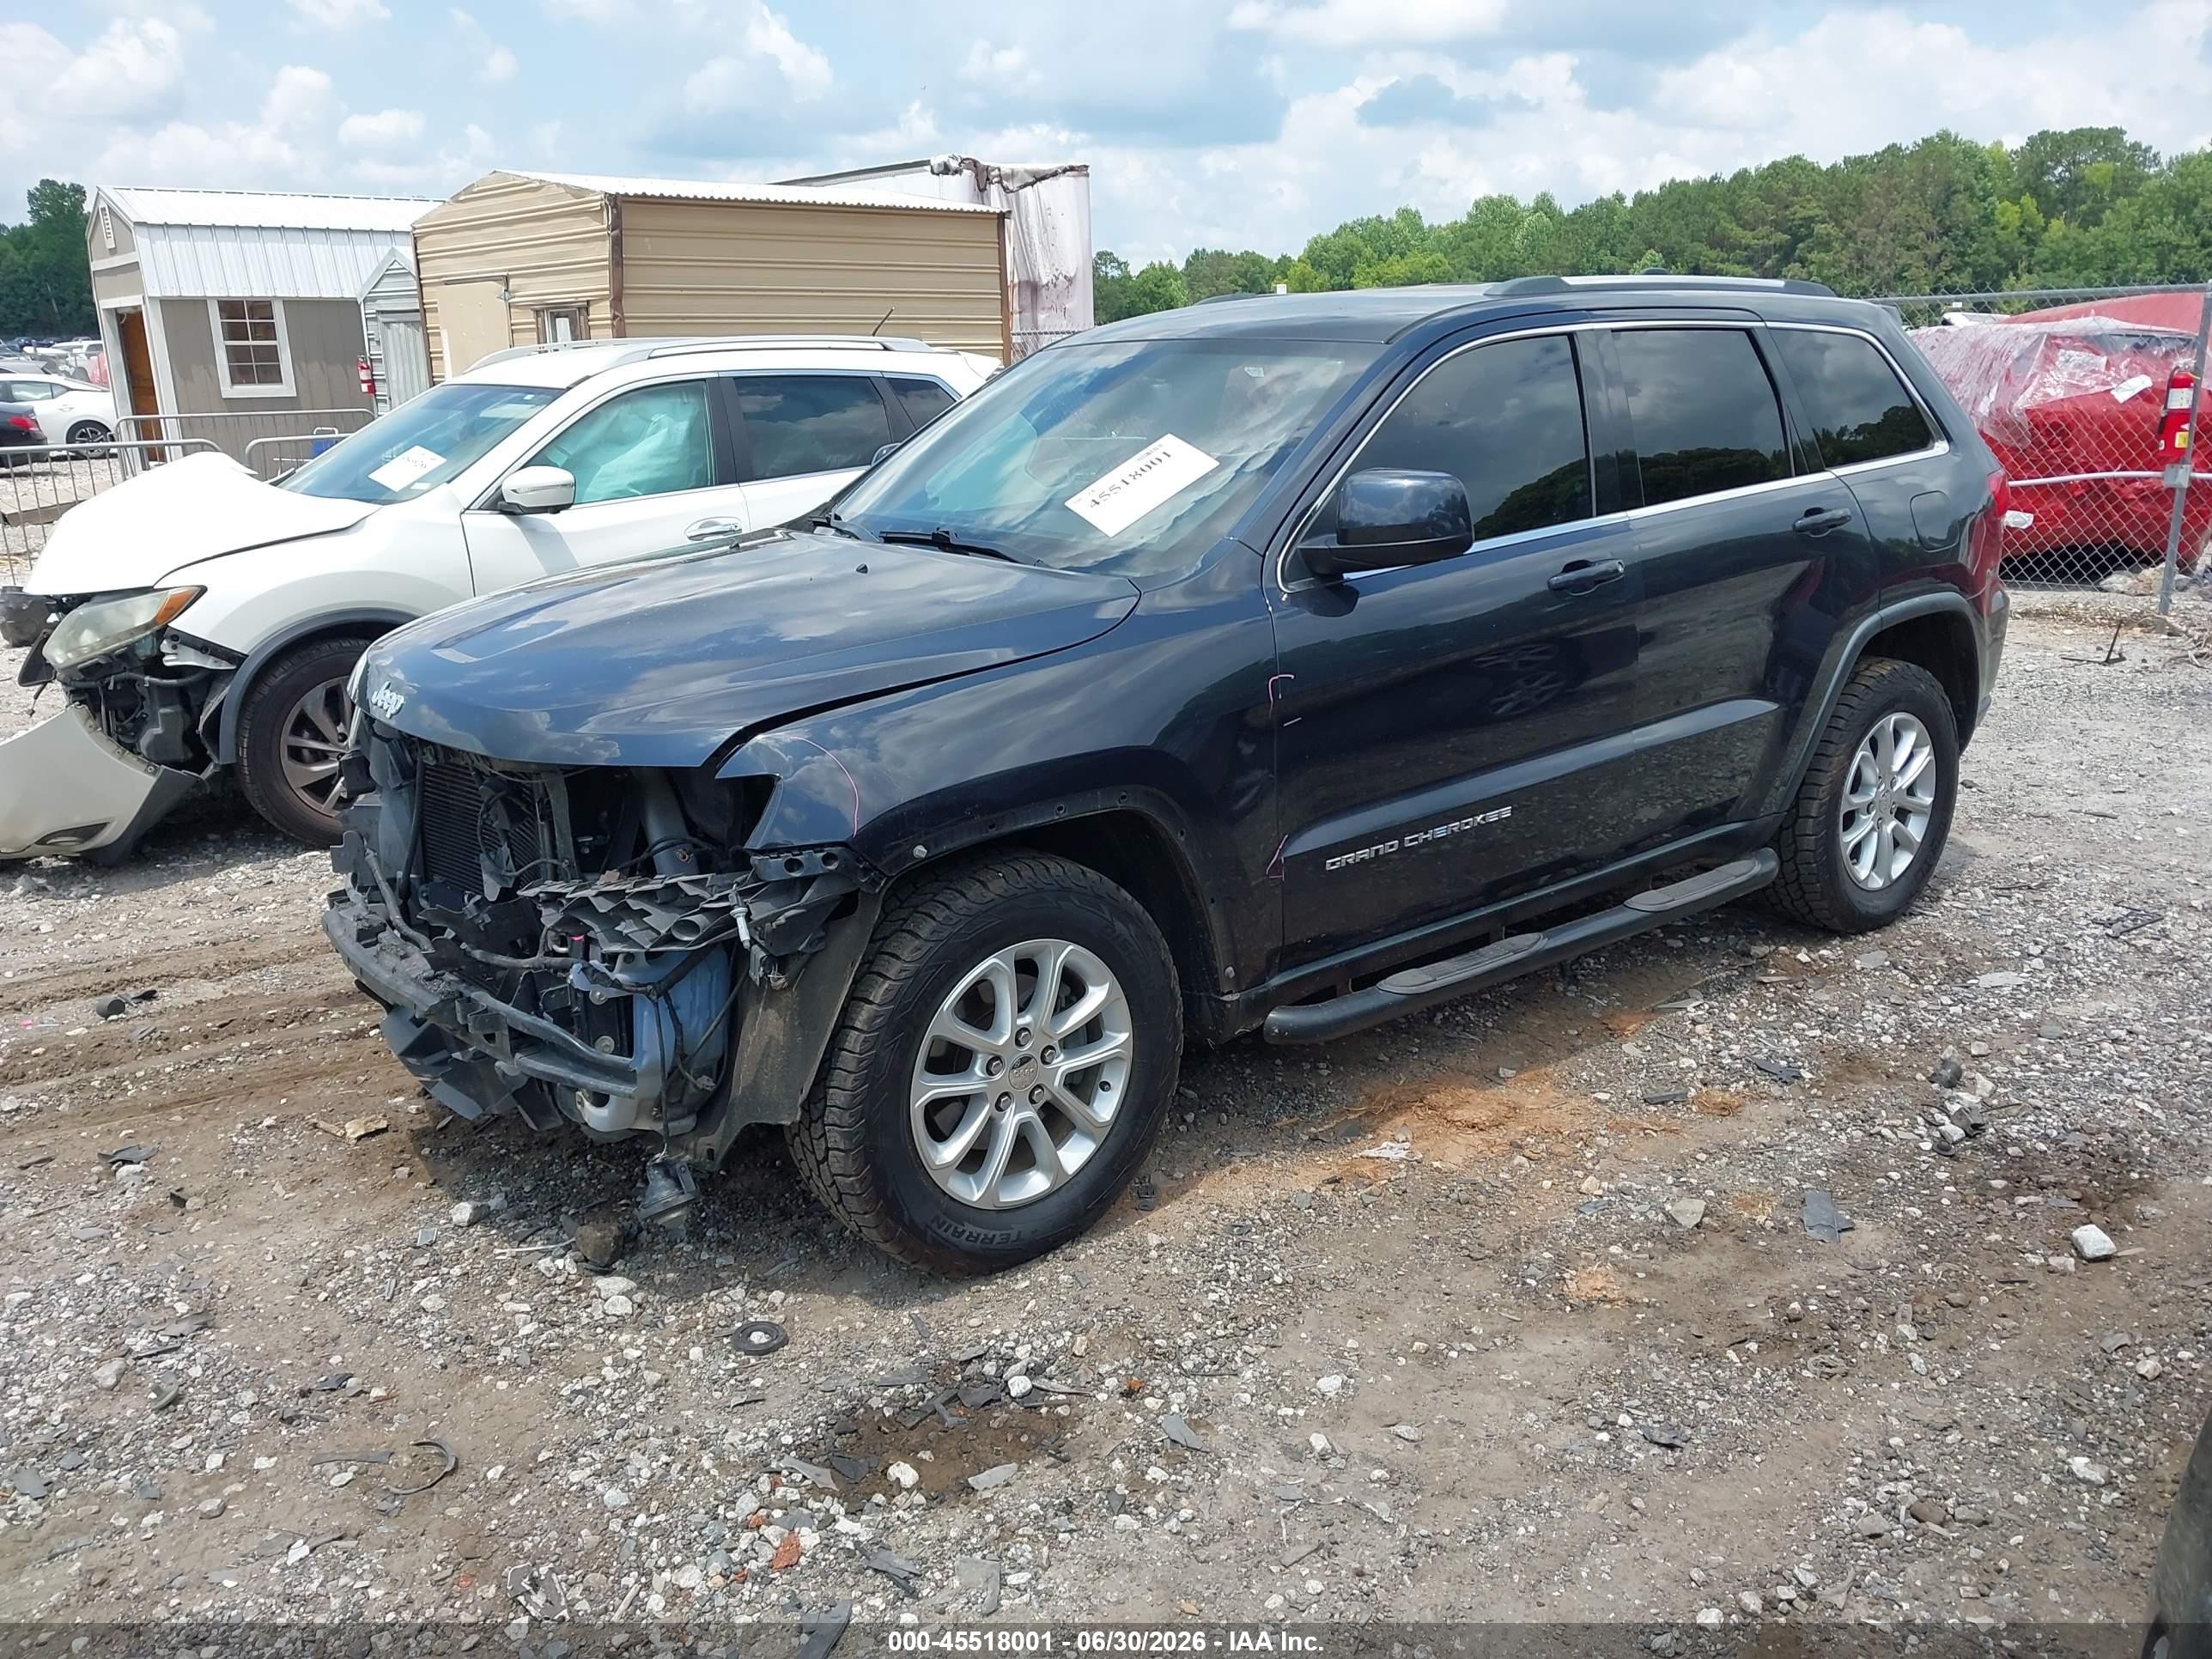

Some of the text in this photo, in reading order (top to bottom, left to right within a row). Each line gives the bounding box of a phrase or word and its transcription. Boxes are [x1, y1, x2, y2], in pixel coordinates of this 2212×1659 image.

[1089, 450, 1176, 509] 45518001
[371, 681, 405, 719] Jeep
[1325, 805, 1513, 872] GRAND CHEROKEE
